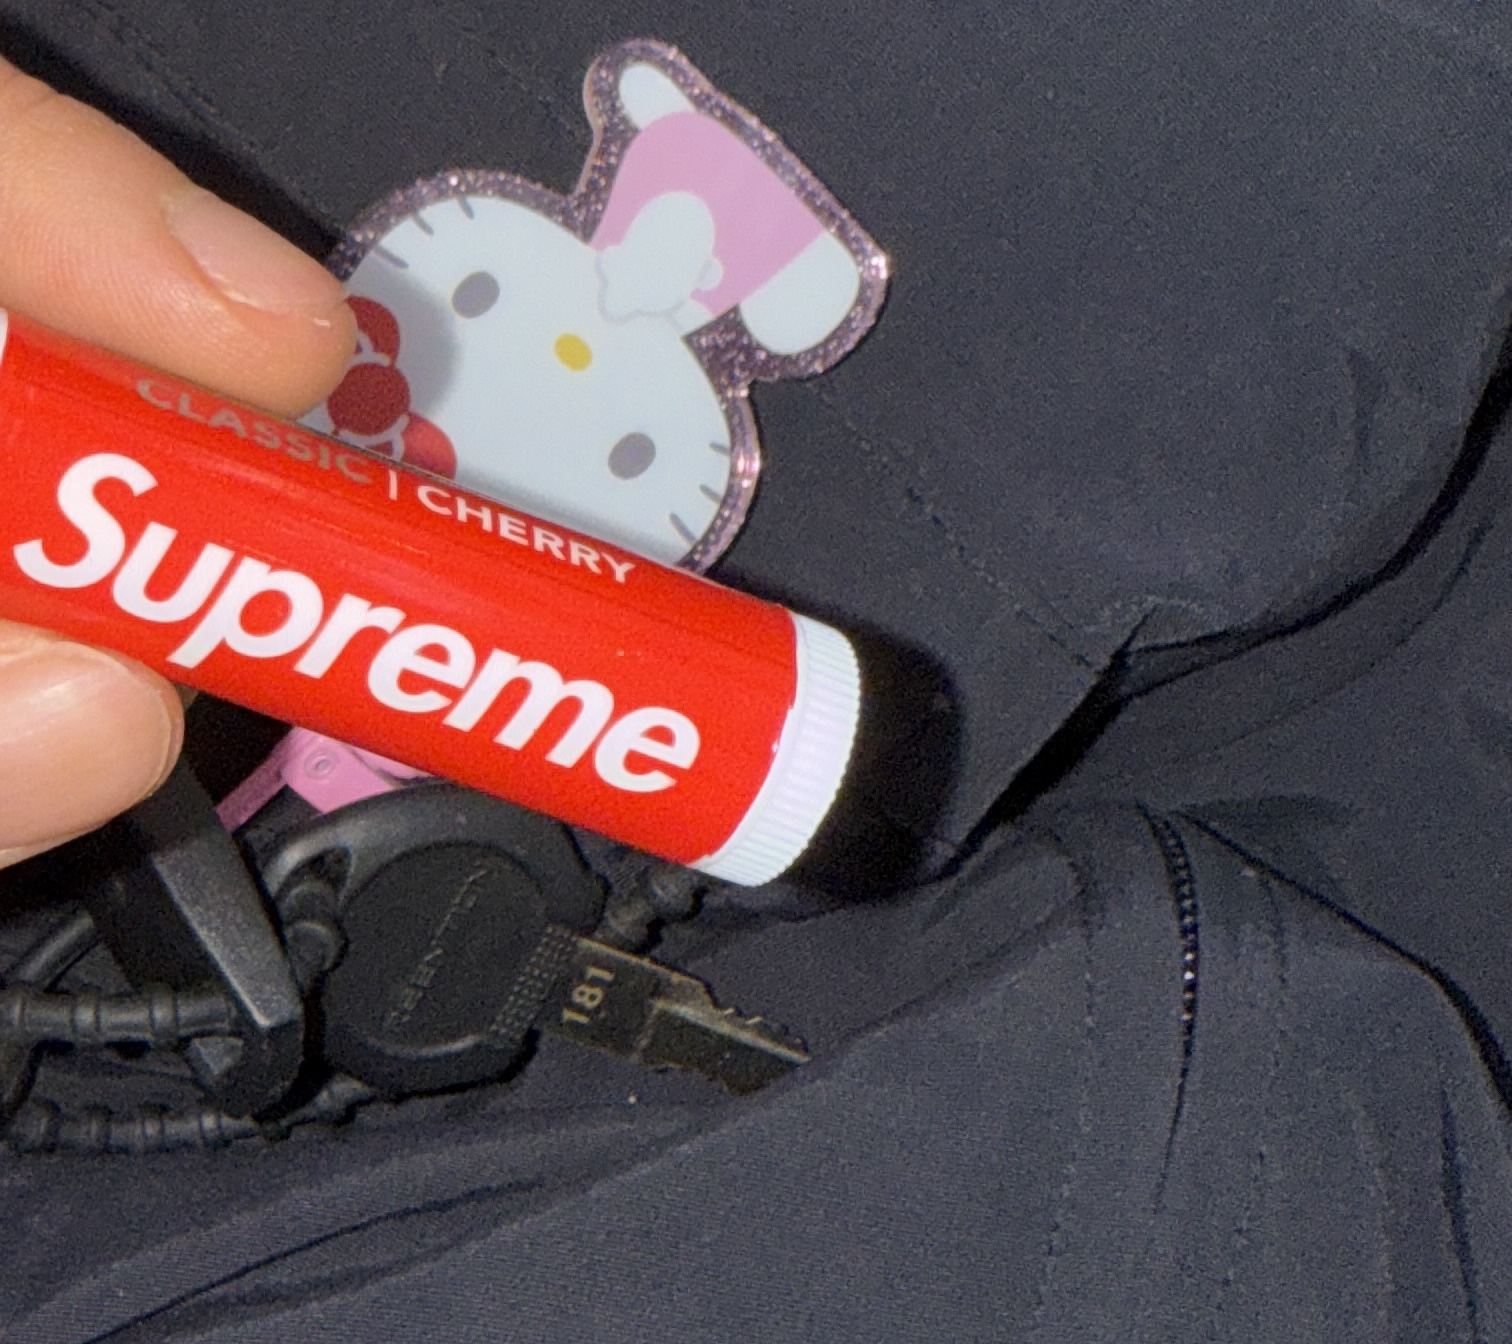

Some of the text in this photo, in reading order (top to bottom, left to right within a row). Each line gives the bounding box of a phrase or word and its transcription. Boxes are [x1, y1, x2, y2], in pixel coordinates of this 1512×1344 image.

[136, 379, 374, 484] CLASSIC
[417, 485, 636, 584] CHERRY
[13, 452, 700, 793] Supreme
[562, 965, 615, 1024] 181
